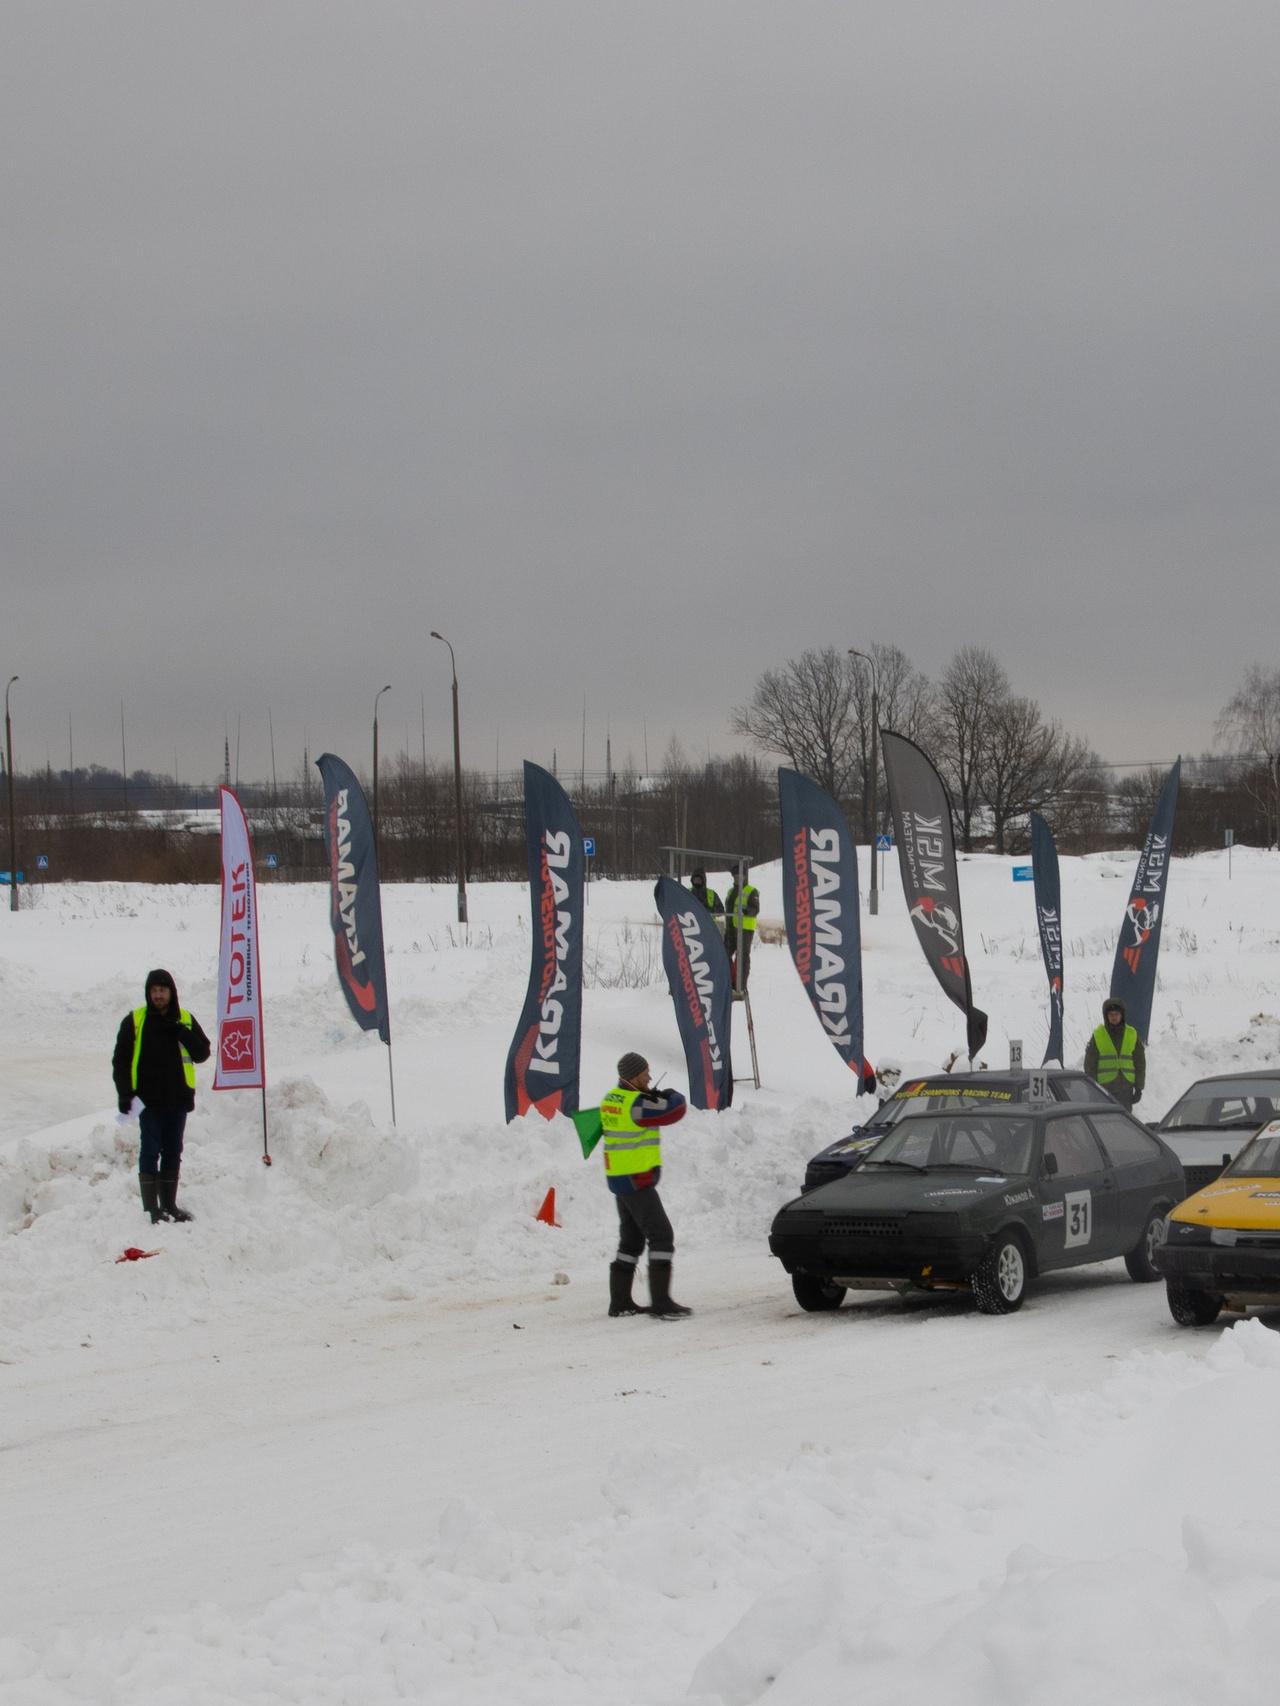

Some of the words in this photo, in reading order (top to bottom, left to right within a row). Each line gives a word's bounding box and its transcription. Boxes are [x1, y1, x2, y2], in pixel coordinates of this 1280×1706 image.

[1011, 1047, 1021, 1062] 13
[920, 1089, 961, 1098] CHAMPIONS
[963, 1089, 989, 1098] RACING
[990, 1091, 1012, 1100] TEAM
[1033, 1077, 1044, 1097] 31
[1070, 1202, 1088, 1236] 31
